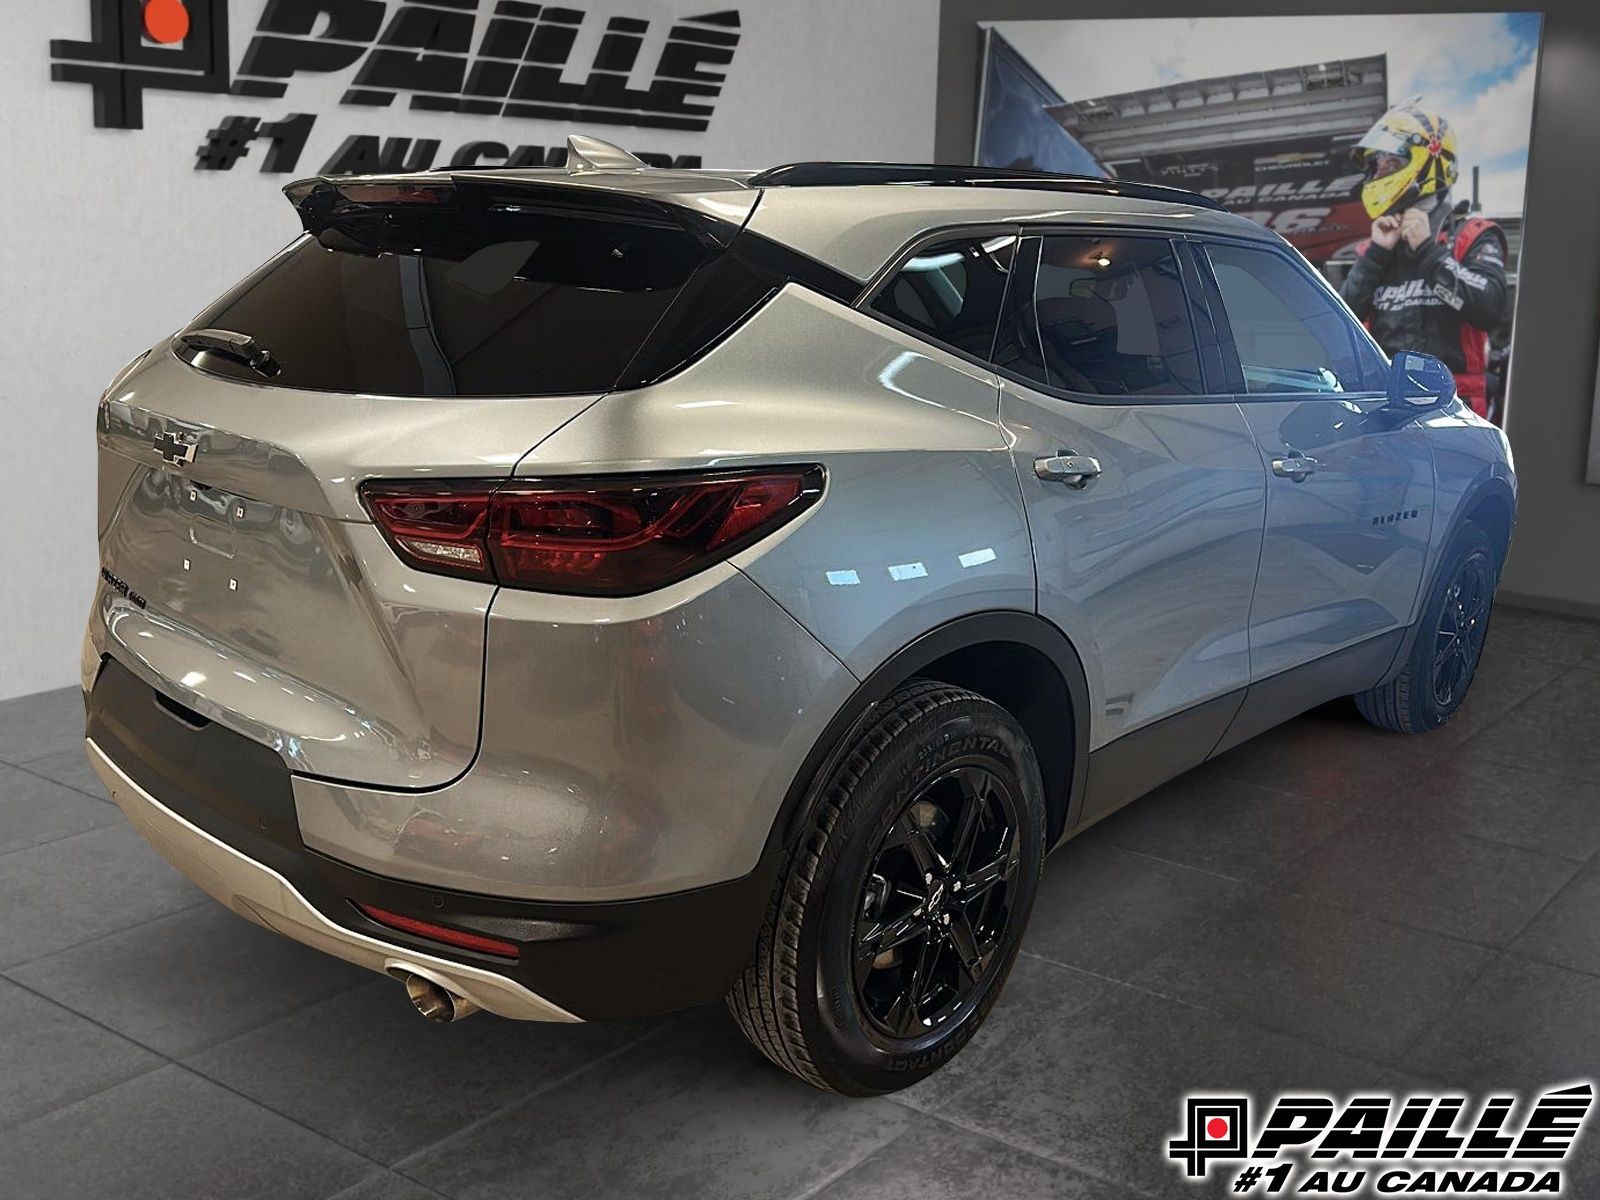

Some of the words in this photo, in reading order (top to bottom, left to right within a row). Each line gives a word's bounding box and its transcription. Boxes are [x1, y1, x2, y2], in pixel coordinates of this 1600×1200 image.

[194, 113, 318, 174] #1
[317, 133, 441, 174] AU
[450, 141, 702, 171] CAN
[1254, 160, 1330, 172] CHEVROLET
[1258, 191, 1351, 203] CANADA
